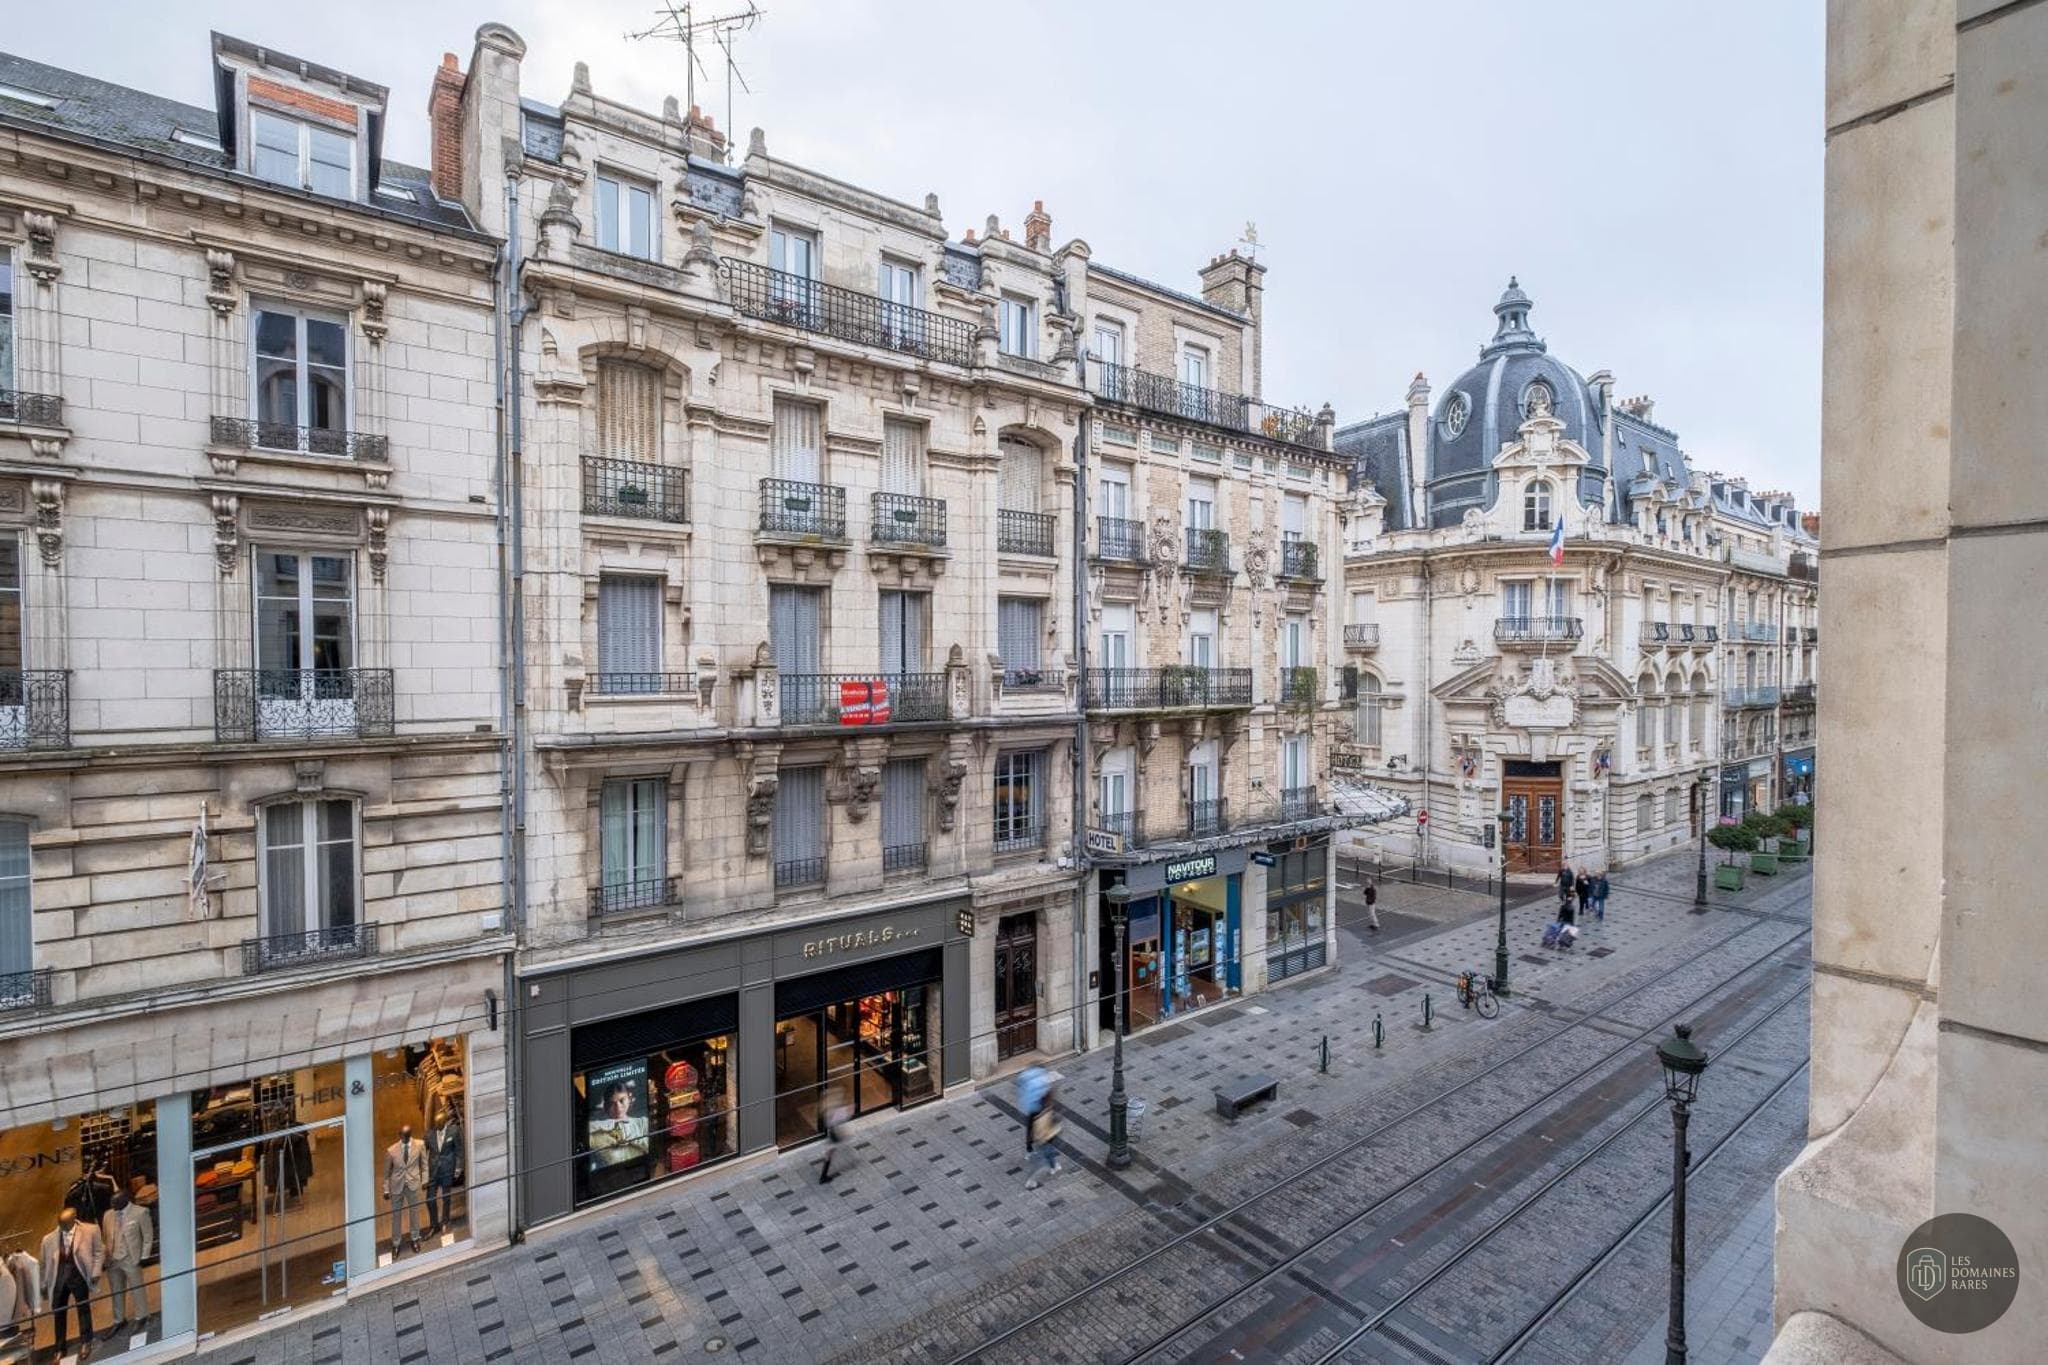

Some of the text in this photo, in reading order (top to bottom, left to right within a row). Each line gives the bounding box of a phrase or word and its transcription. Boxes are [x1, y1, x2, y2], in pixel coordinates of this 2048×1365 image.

[1089, 831, 1116, 850] HOTEL
[1168, 857, 1215, 874] NAVITOUR
[350, 1079, 365, 1095] &
